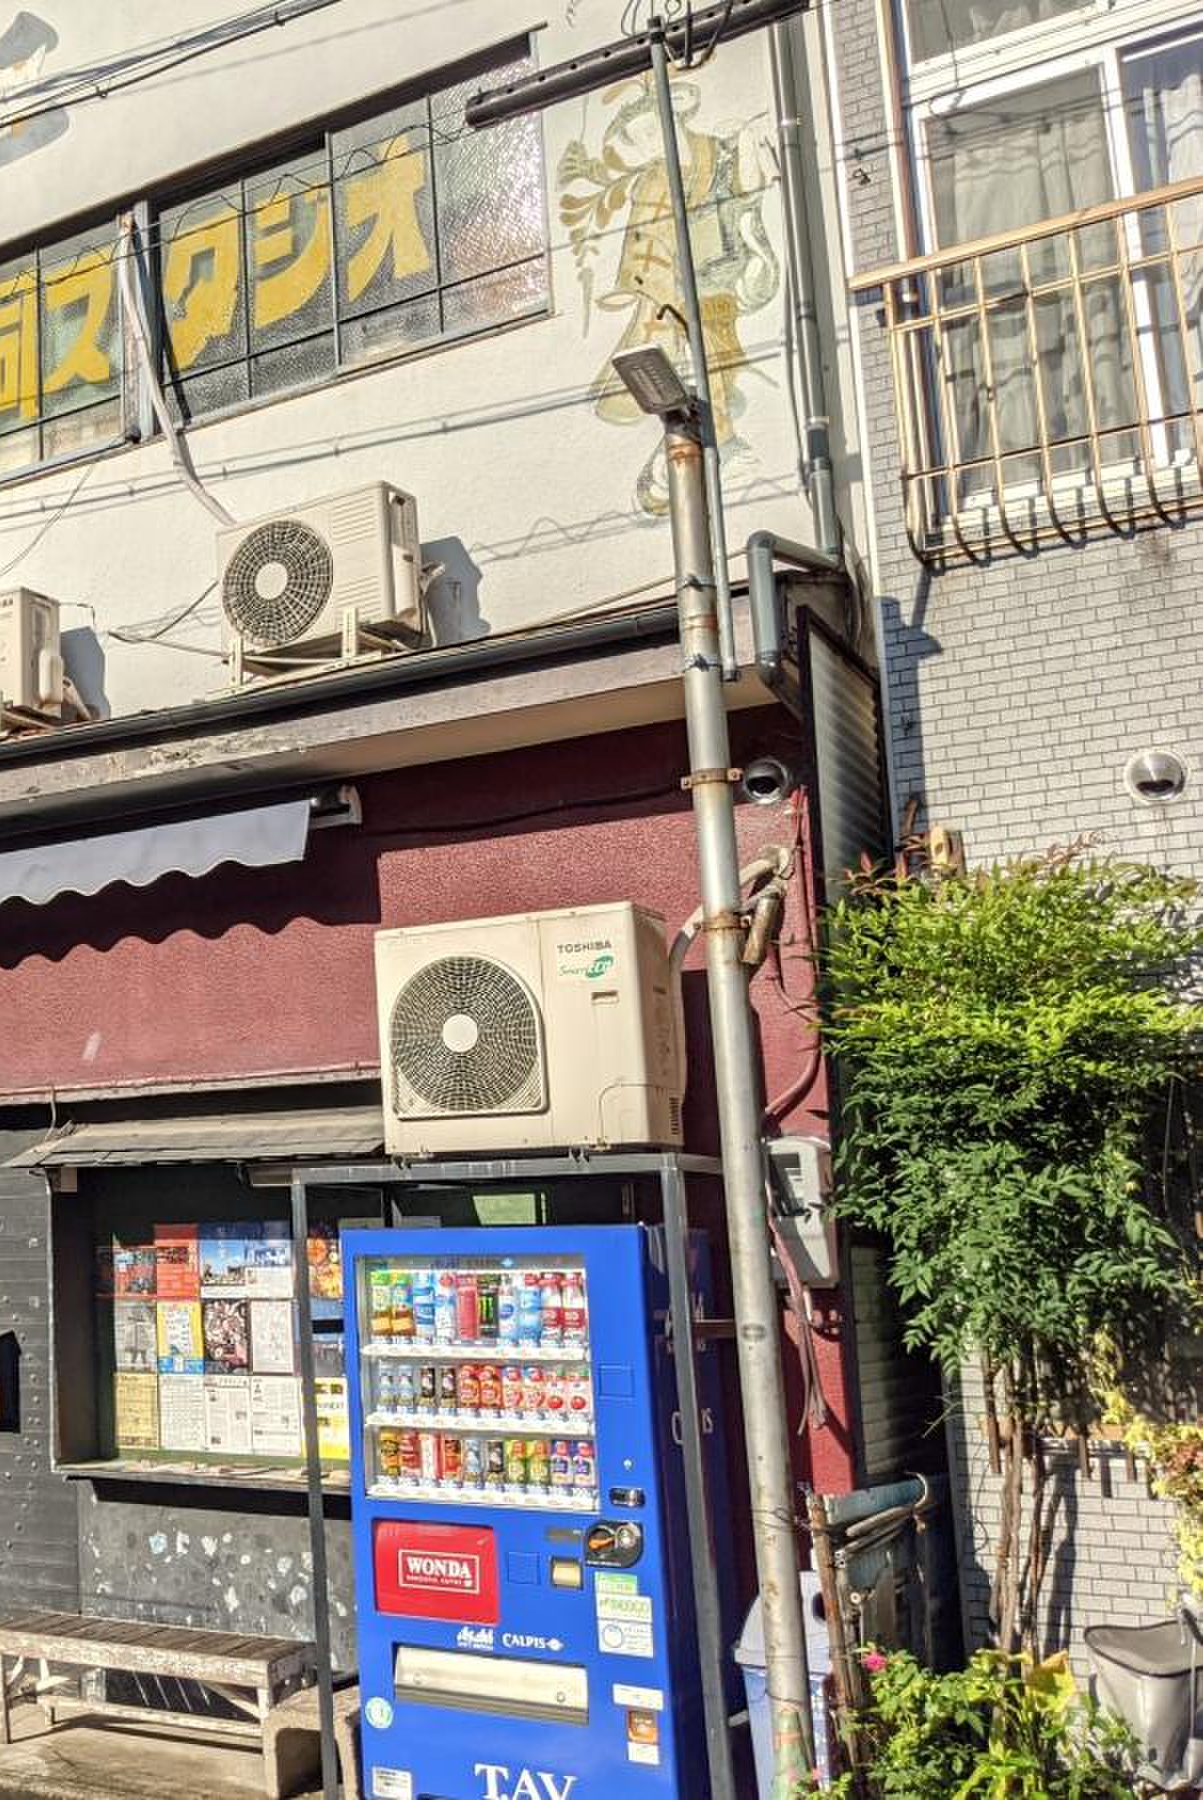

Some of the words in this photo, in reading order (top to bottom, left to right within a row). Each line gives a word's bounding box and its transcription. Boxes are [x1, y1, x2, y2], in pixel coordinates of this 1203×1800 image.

[557, 940, 612, 954] TOSHIBA
[406, 1557, 473, 1579] WONDA
[502, 1633, 547, 1649] CALPIS
